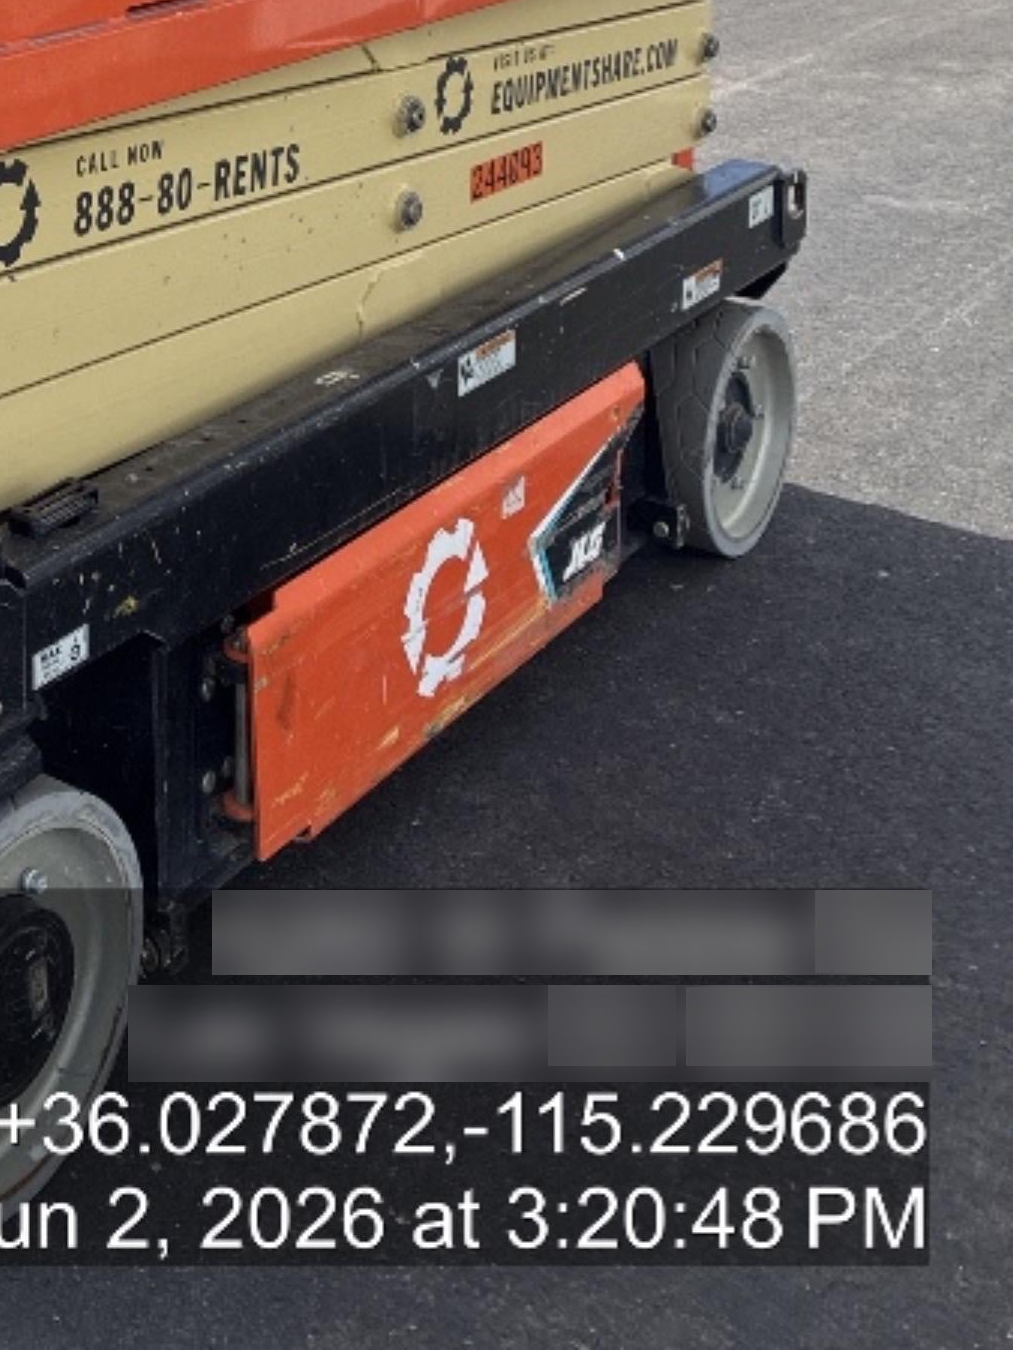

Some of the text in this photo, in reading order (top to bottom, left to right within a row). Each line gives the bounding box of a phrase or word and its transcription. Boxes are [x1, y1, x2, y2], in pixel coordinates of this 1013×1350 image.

[491, 39, 678, 115] EQUIPMENTSHARE.COM
[74, 144, 301, 236] 888-80-RENTS
[76, 141, 165, 177] CALL NOW
[472, 140, 543, 201] 244093
[562, 521, 606, 583] JLG
